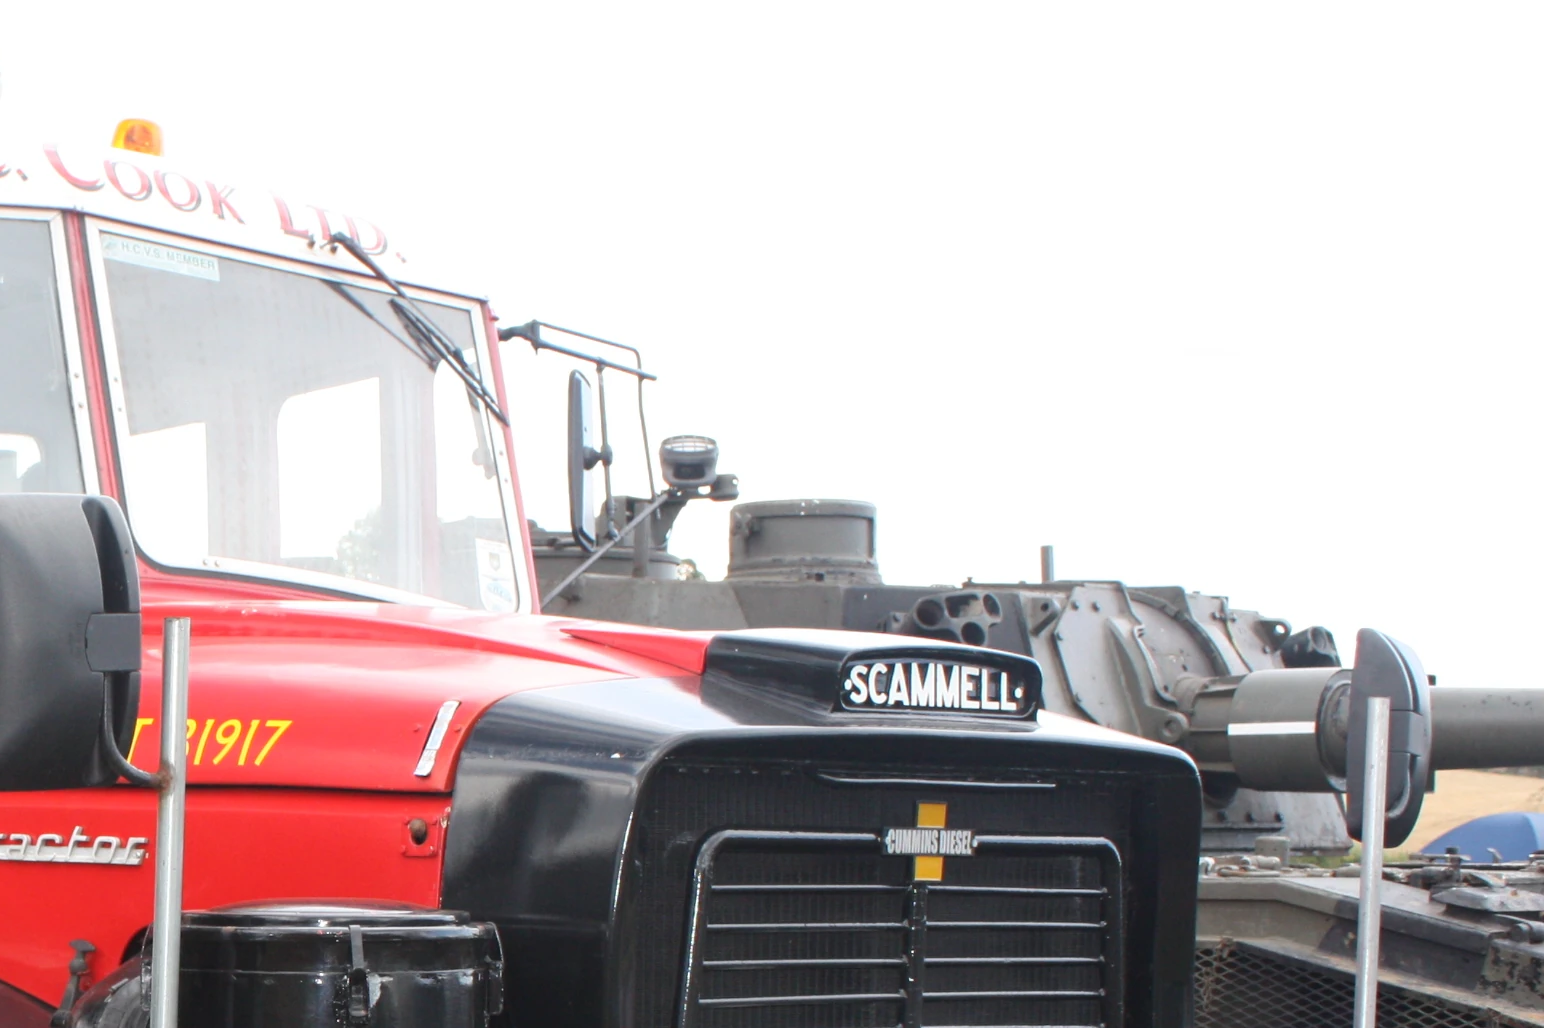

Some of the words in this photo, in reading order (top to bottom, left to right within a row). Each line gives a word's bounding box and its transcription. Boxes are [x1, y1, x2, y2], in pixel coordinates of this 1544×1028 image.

[42, 144, 246, 226] COOK
[166, 251, 216, 270] MEMBER
[849, 662, 1018, 711] SCAMMELL
[886, 828, 938, 854] CUMMINS
[939, 829, 973, 855] DIESEL
